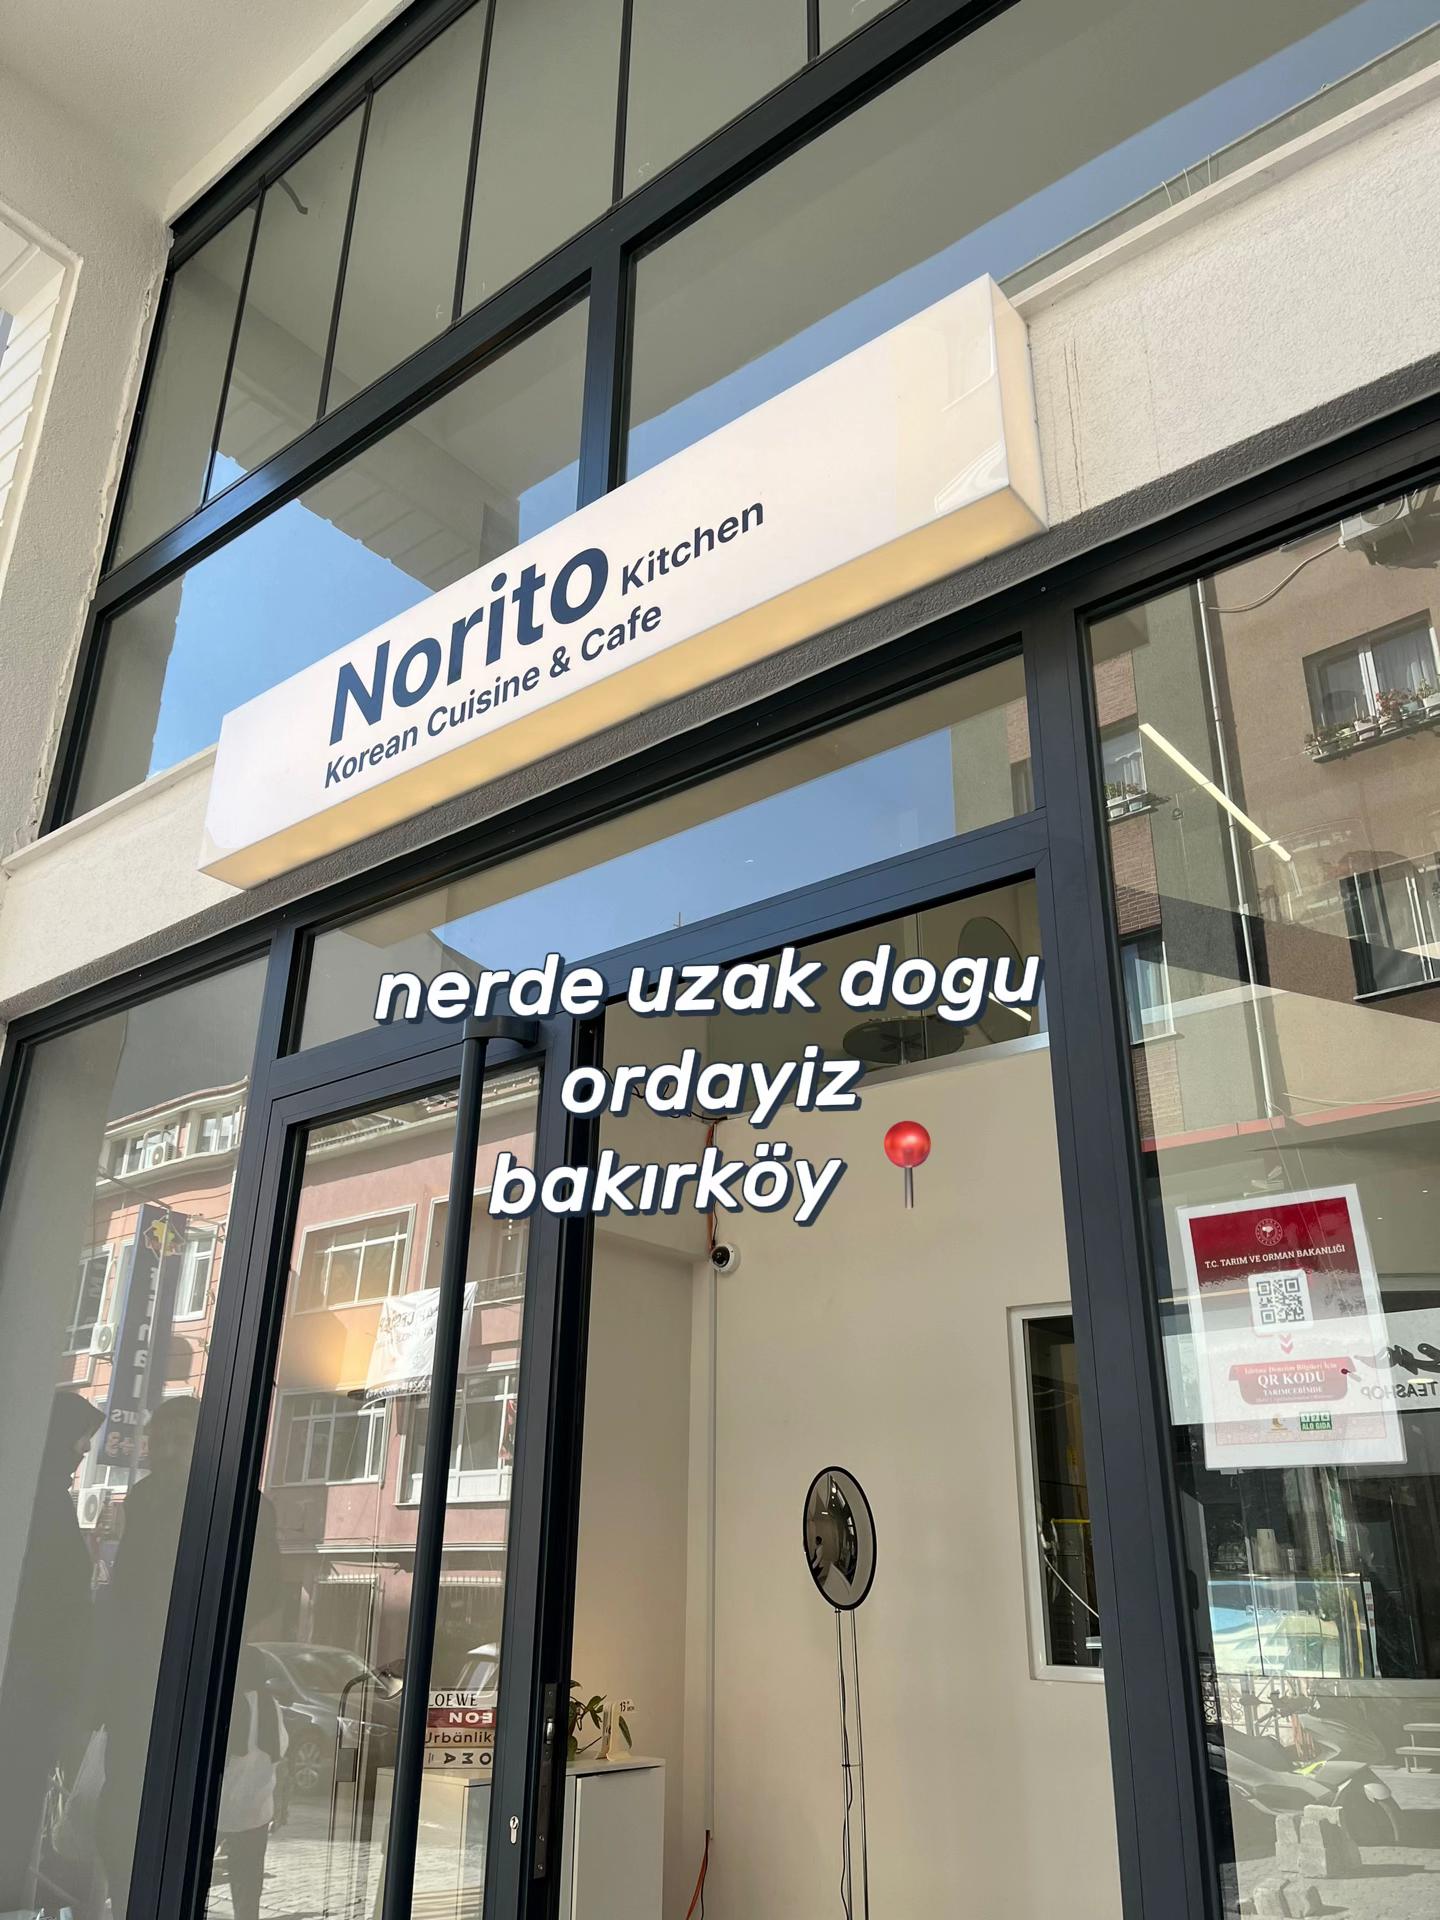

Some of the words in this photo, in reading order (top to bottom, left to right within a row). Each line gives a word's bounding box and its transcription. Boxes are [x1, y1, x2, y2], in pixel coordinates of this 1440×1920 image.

[328, 547, 610, 747] Norito
[621, 501, 765, 596] Kitchen
[324, 724, 418, 789] Korean
[428, 667, 540, 737] Cuisine
[549, 645, 571, 678] &
[581, 603, 662, 663] Cafe
[1204, 1260, 1219, 1269] T.C.
[1220, 1255, 1248, 1267] TARIM
[1249, 1255, 1261, 1264] VE
[1262, 1250, 1295, 1262] ORMAN
[1296, 1244, 1346, 1258] BAKANLIĞI
[1257, 1373, 1279, 1388] QR
[1283, 1370, 1326, 1385] KODU
